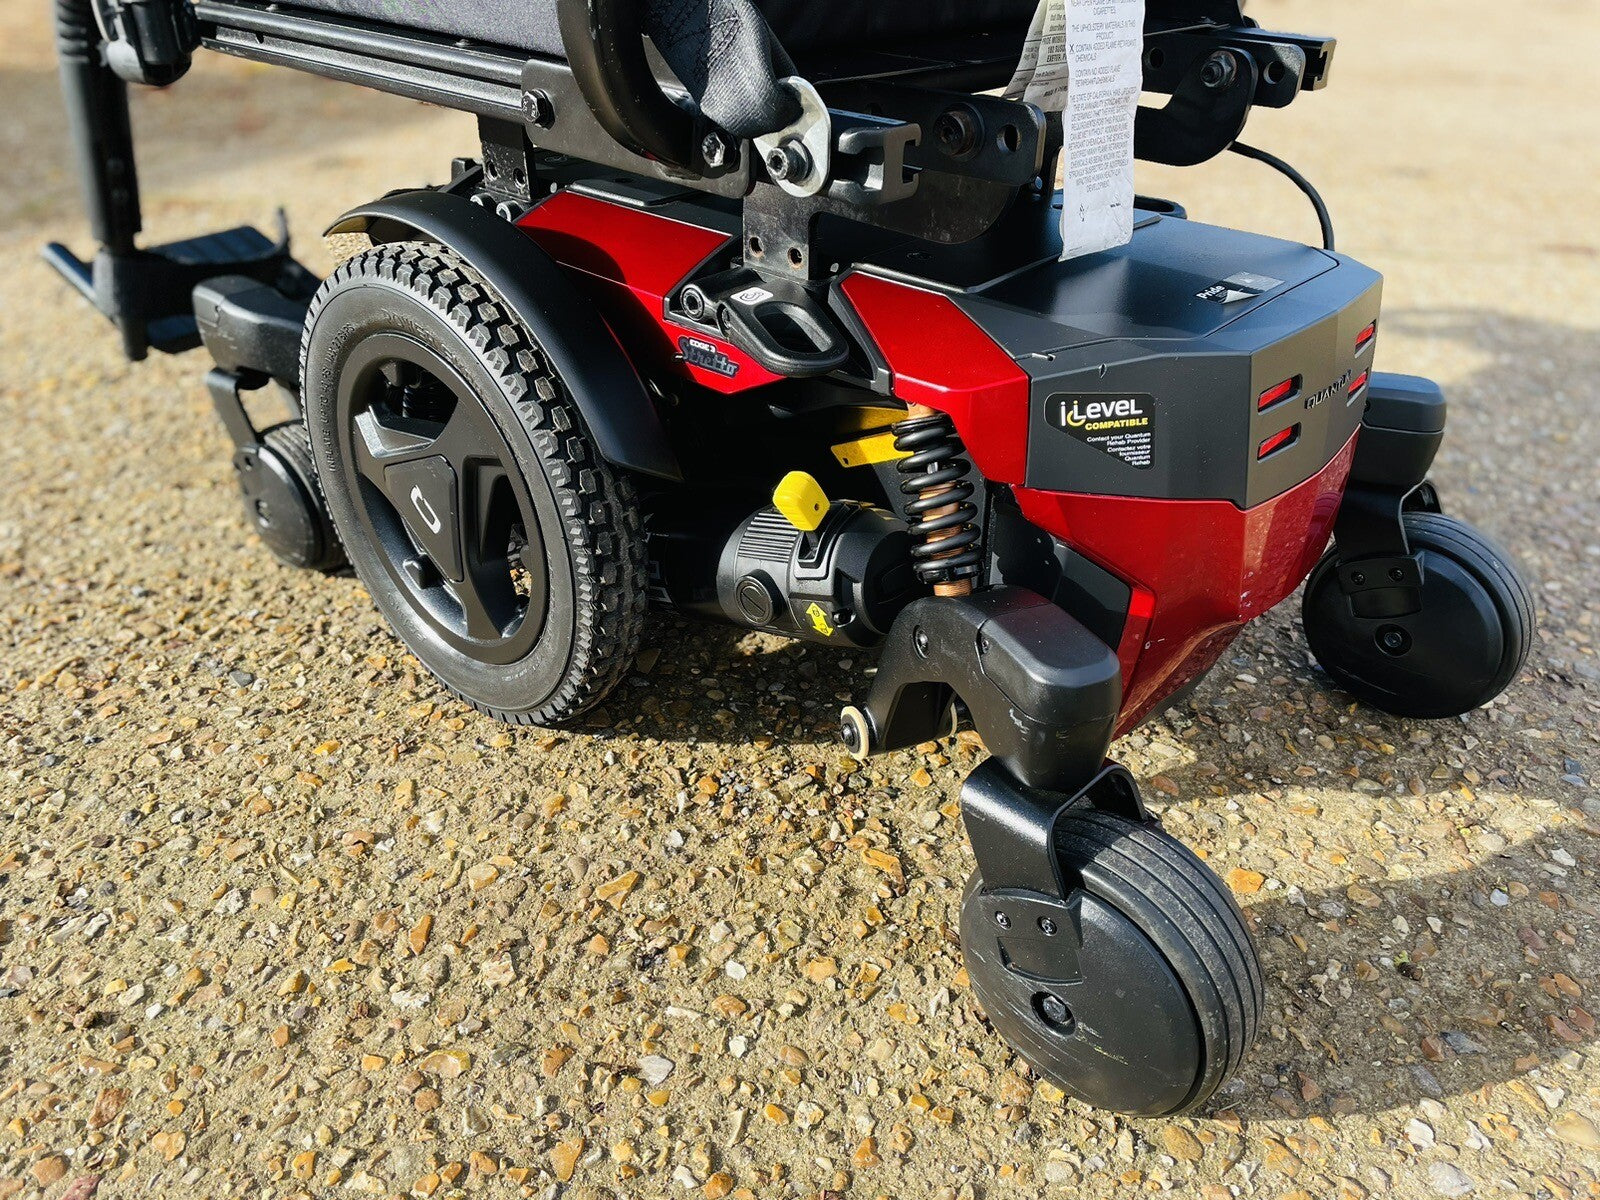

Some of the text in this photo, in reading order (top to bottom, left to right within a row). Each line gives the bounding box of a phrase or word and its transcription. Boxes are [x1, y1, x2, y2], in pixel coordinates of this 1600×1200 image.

[1196, 286, 1225, 298] Pride
[675, 338, 738, 376] Stretto
[1085, 417, 1148, 430] COMPATIBLE
